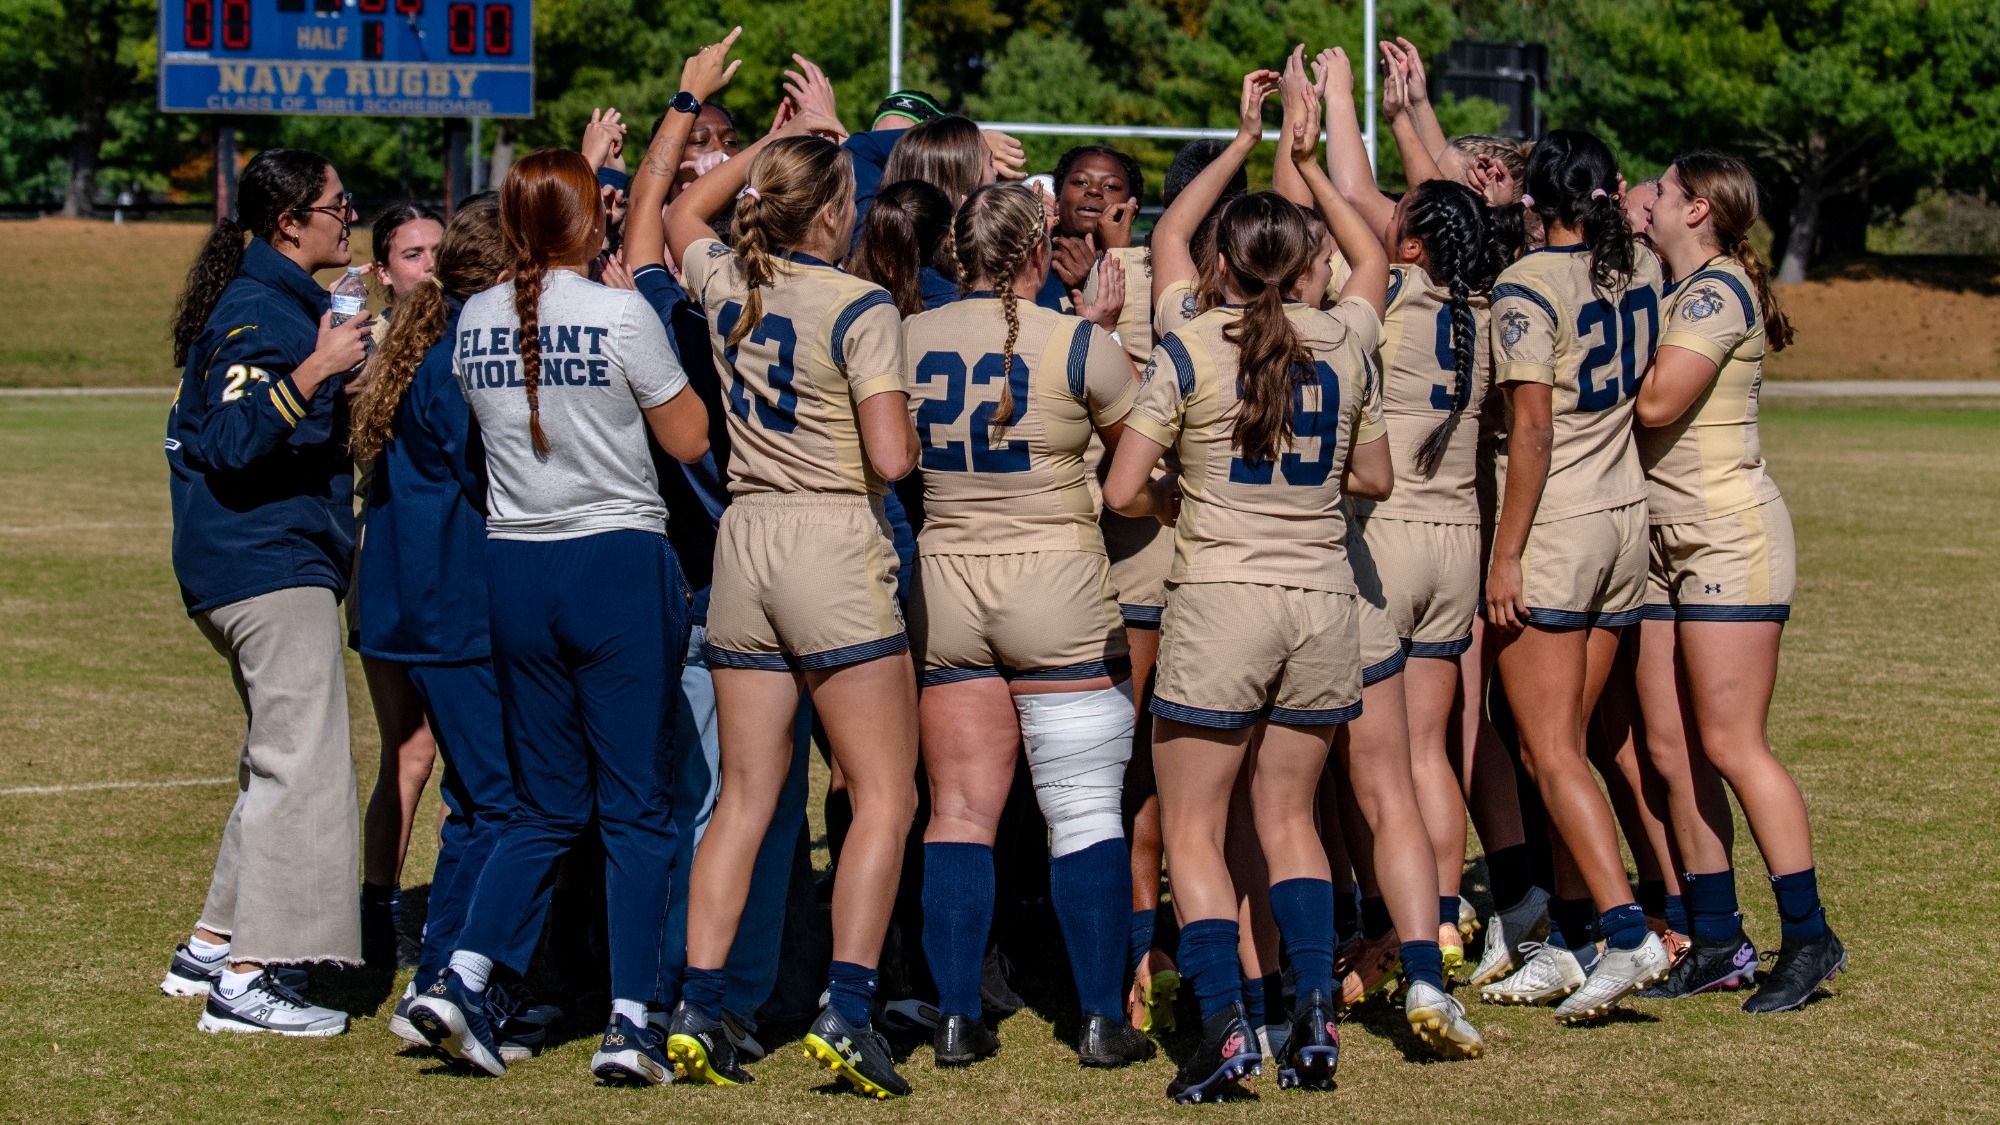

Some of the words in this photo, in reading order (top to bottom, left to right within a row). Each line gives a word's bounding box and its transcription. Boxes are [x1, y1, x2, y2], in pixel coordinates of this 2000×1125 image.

[297, 26, 348, 50] HALF
[450, 4, 511, 54] 00
[206, 95, 273, 110] CLASS
[281, 96, 307, 111] OF
[363, 98, 492, 114] SCOREBOARD
[218, 65, 331, 95] NAVY
[345, 68, 479, 98] RUGBY
[717, 300, 798, 434] 13
[1429, 302, 1476, 411] 9
[1576, 284, 1660, 412] 20
[462, 358, 611, 390] VIOLNCE
[915, 351, 1031, 473] 22
